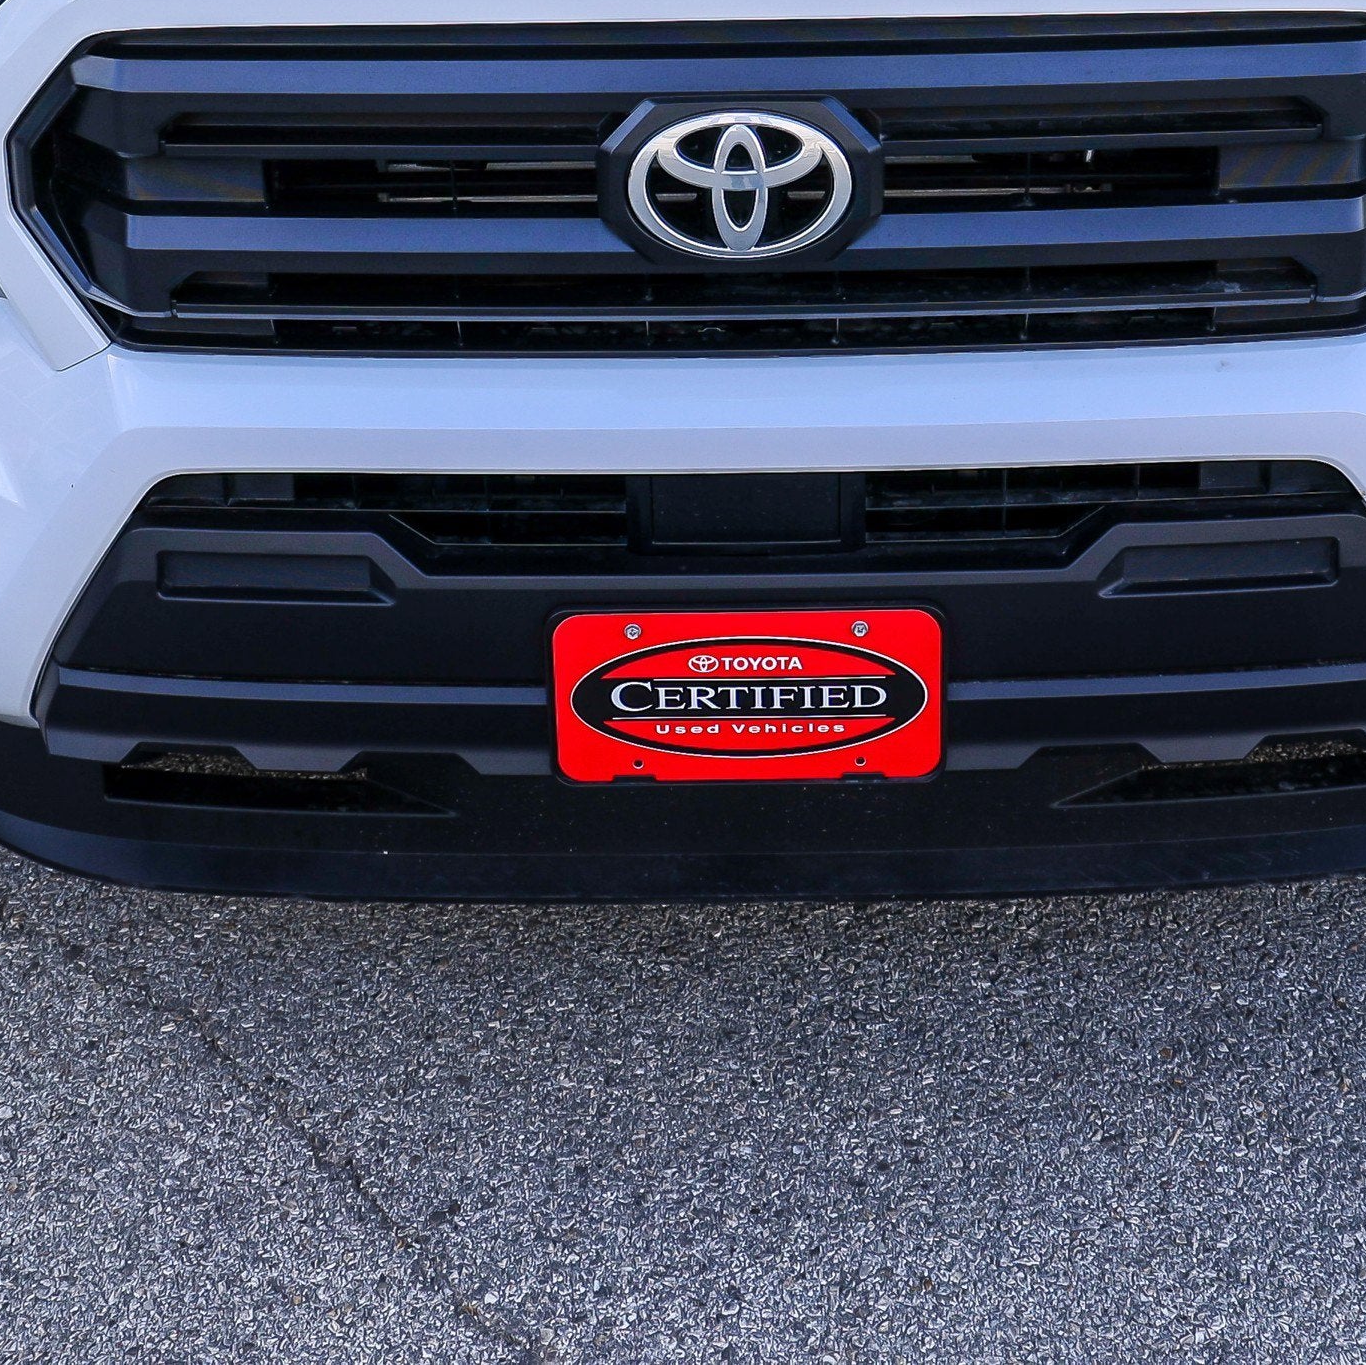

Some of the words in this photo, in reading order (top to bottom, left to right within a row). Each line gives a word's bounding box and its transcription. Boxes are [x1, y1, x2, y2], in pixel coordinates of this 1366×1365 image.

[721, 656, 803, 671] TOYOTA
[611, 681, 887, 712] CERTIFIED
[656, 724, 719, 734] Used
[732, 723, 845, 734] Vehicles
